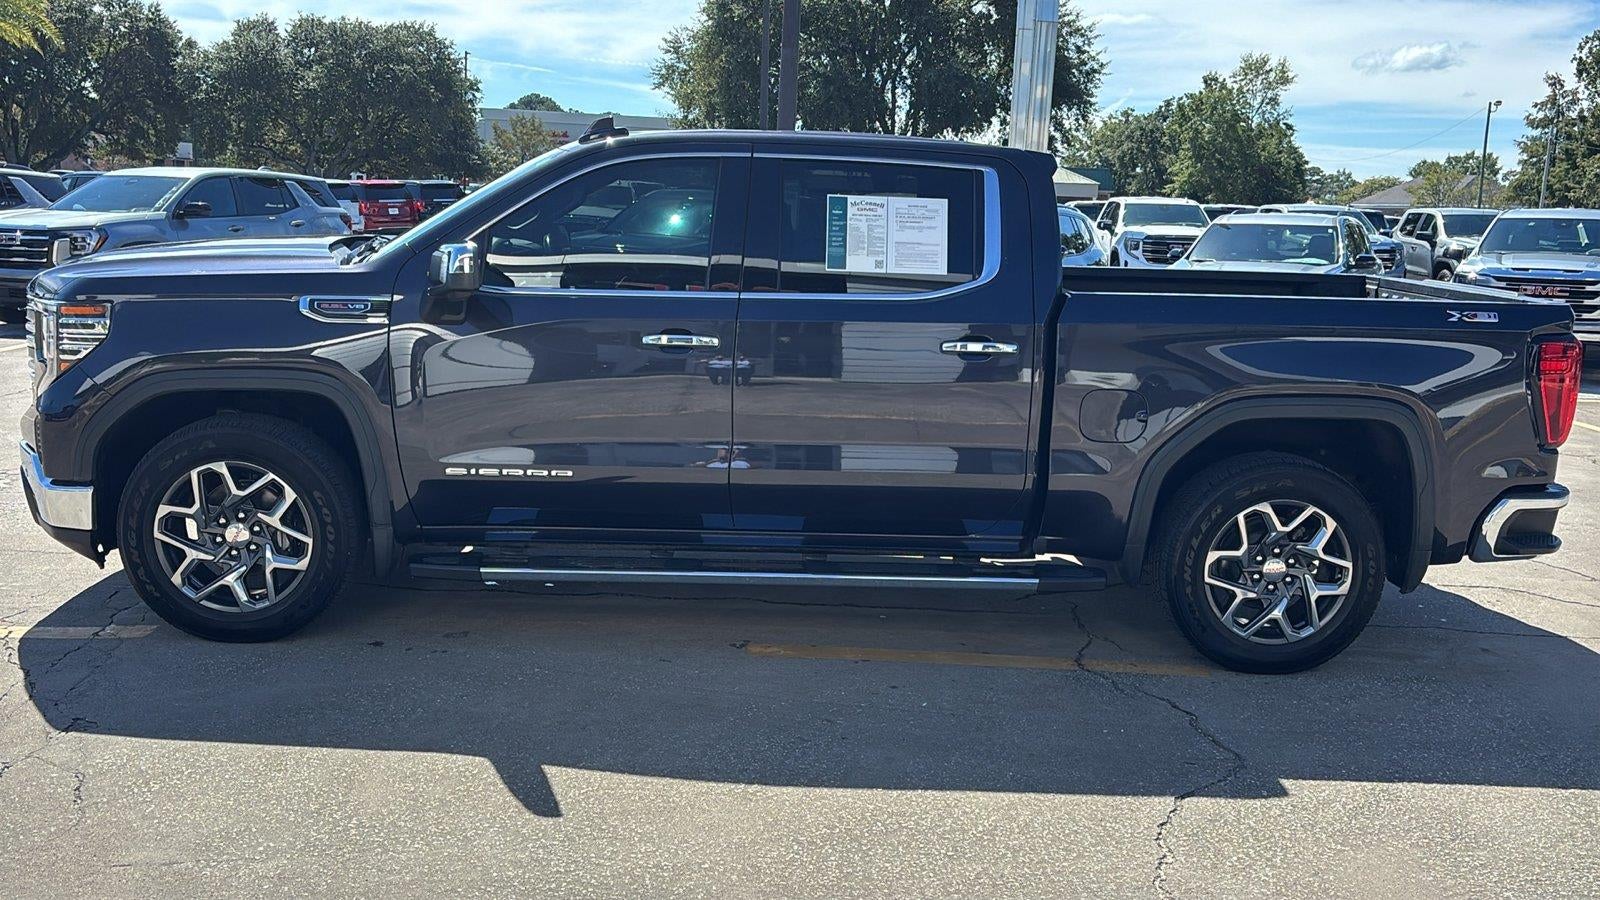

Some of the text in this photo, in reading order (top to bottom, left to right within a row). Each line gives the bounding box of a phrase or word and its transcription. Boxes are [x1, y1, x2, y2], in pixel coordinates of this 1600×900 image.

[850, 200, 885, 209] McConnell
[1519, 285, 1570, 296] GMC
[445, 467, 574, 478] SIERRA
